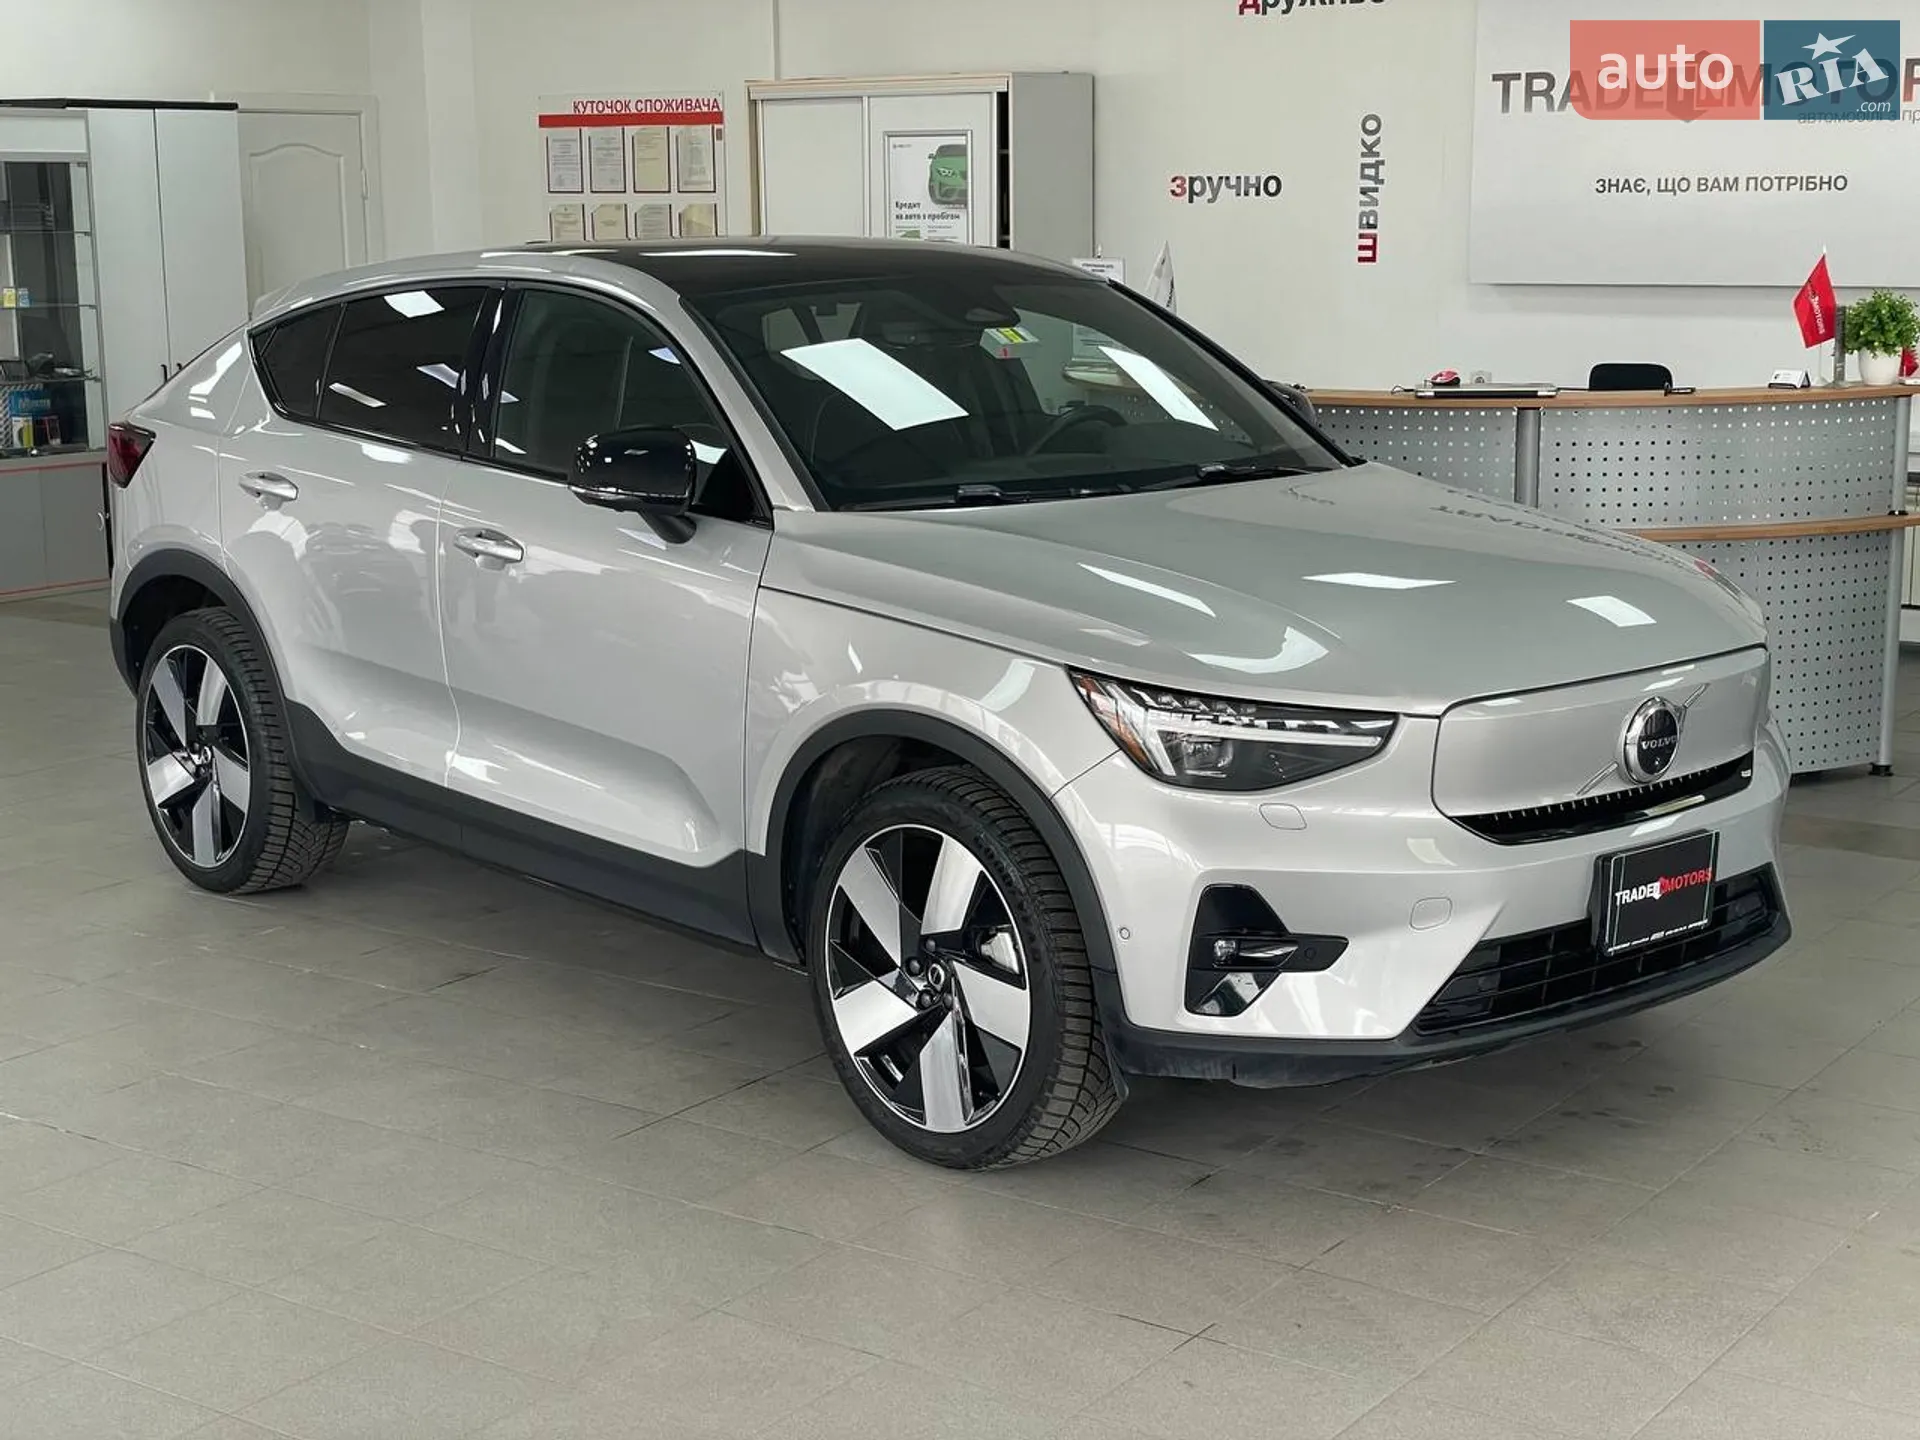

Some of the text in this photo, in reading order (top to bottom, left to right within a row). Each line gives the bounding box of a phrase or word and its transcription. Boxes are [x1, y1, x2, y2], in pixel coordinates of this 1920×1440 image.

[573, 98, 721, 114] КУТОЧОК СПОЖИВАЧА
[1170, 175, 1282, 203] зручно
[1595, 175, 1848, 196] ЗНАЄ, ЩО ВАМ ПОТРІБНО
[1641, 735, 1677, 750] VOLVO
[1614, 867, 1713, 907] TRADE MOTORS
